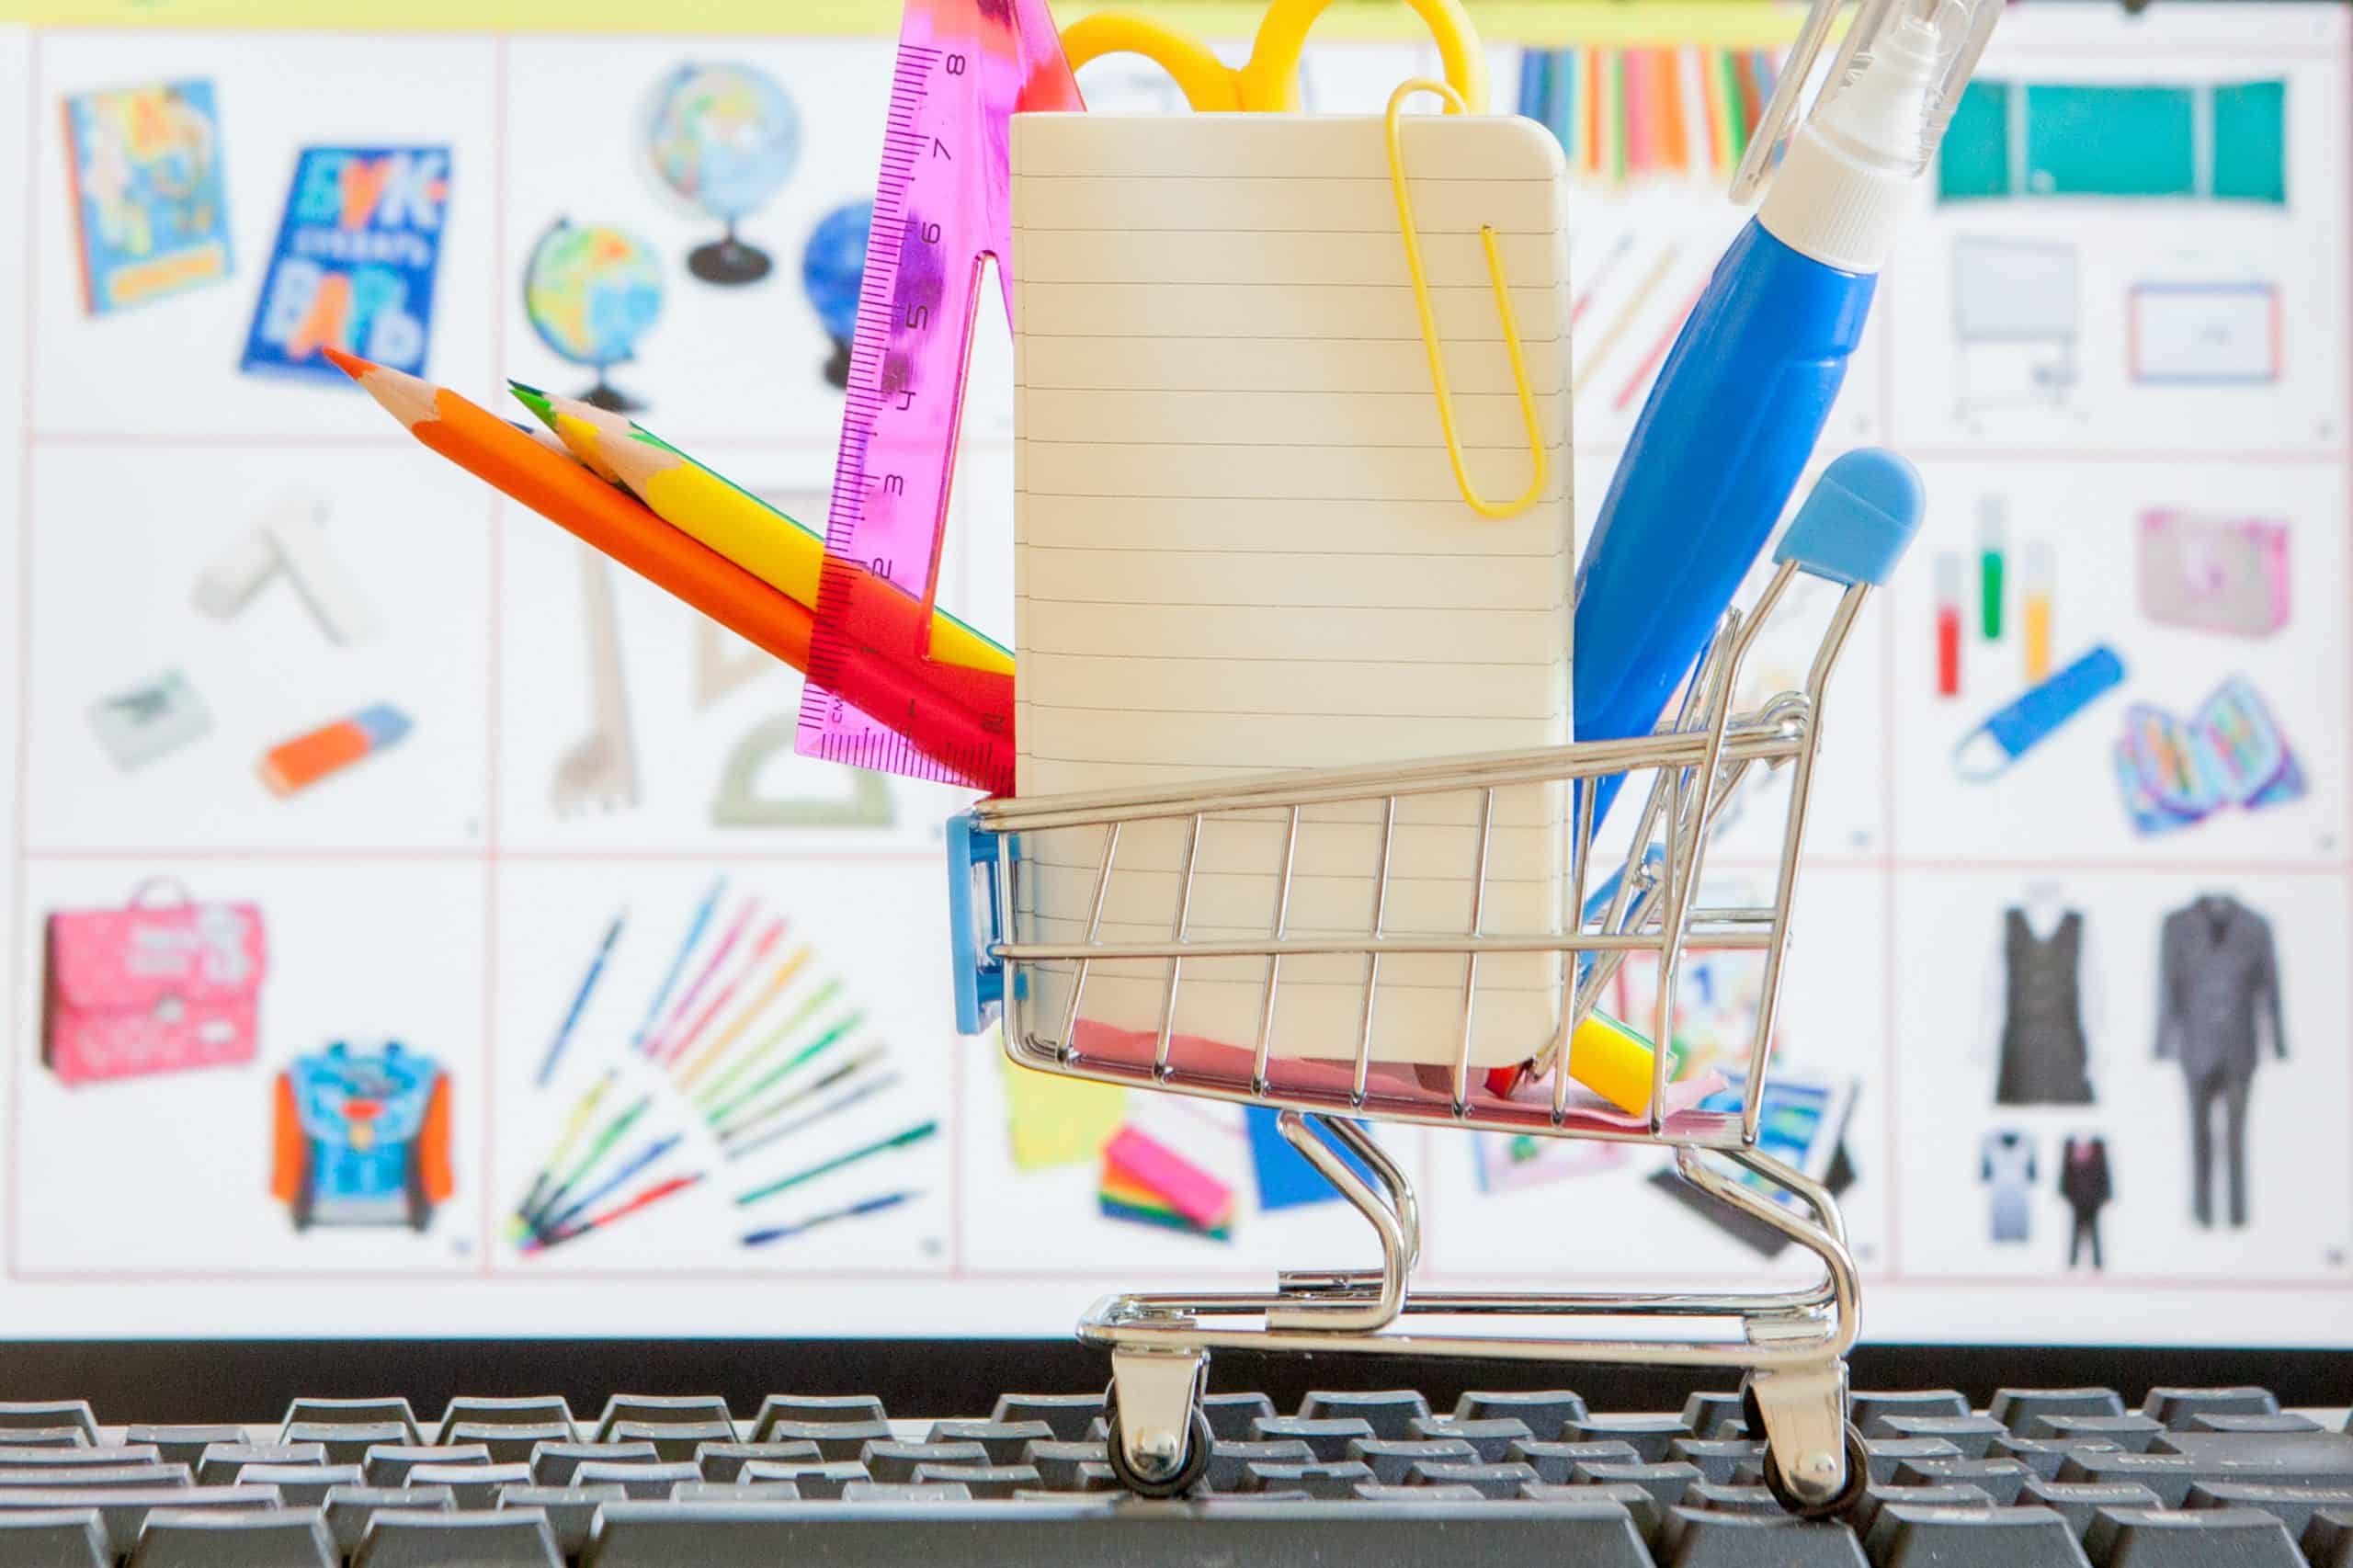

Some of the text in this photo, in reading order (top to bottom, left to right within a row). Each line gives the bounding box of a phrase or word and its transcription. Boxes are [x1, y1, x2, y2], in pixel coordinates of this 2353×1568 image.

[945, 53, 966, 76] 8
[932, 137, 952, 161] 7
[920, 222, 941, 244] 6
[904, 303, 928, 331] 5
[894, 389, 917, 412] 4
[883, 473, 904, 496] 3
[870, 557, 893, 580] 2
